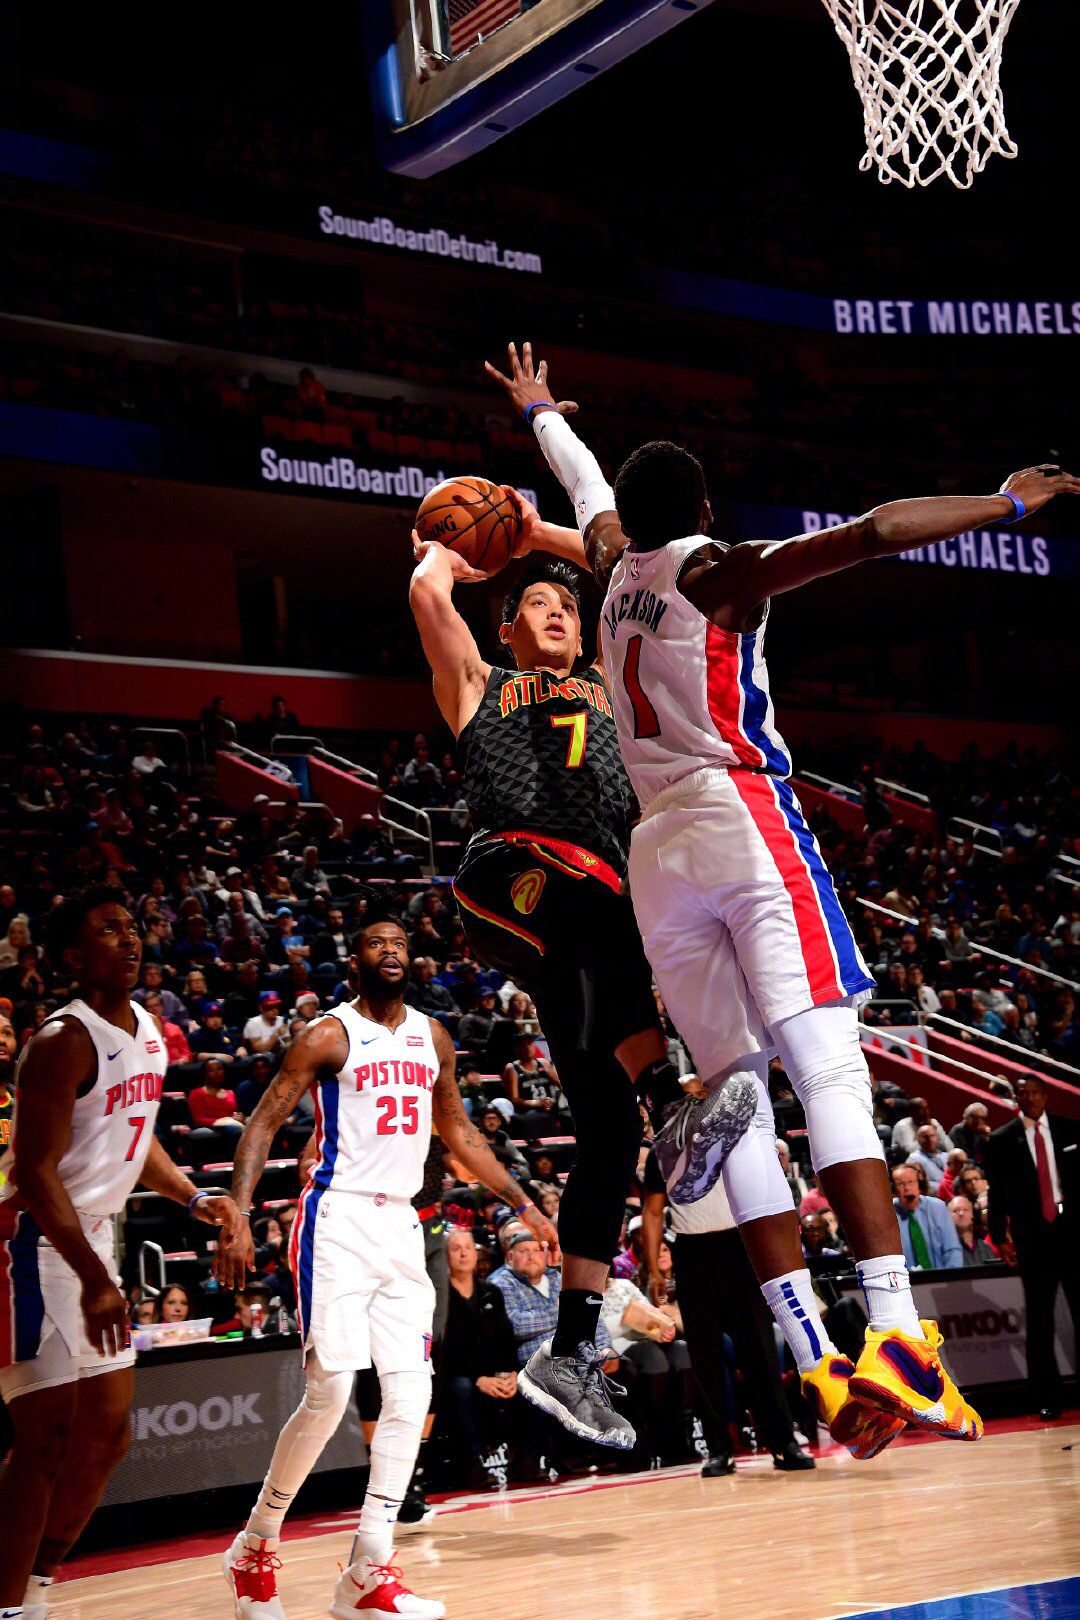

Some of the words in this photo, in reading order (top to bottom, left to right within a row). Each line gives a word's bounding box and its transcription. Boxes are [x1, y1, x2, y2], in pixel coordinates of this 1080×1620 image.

[318, 205, 542, 274] SoundBoardDetroit.com
[833, 299, 914, 334] BRET
[927, 301, 1080, 335] MICHAELS
[604, 588, 668, 640] JACKSON
[499, 673, 613, 718] ATLANTA
[623, 633, 662, 739] 1
[550, 711, 588, 769] 7
[104, 1072, 163, 1116] PISTON
[353, 1060, 435, 1093] PISTONS
[376, 1095, 419, 1136] 25
[125, 1116, 146, 1161] 7
[130, 1392, 264, 1440] KOOK
